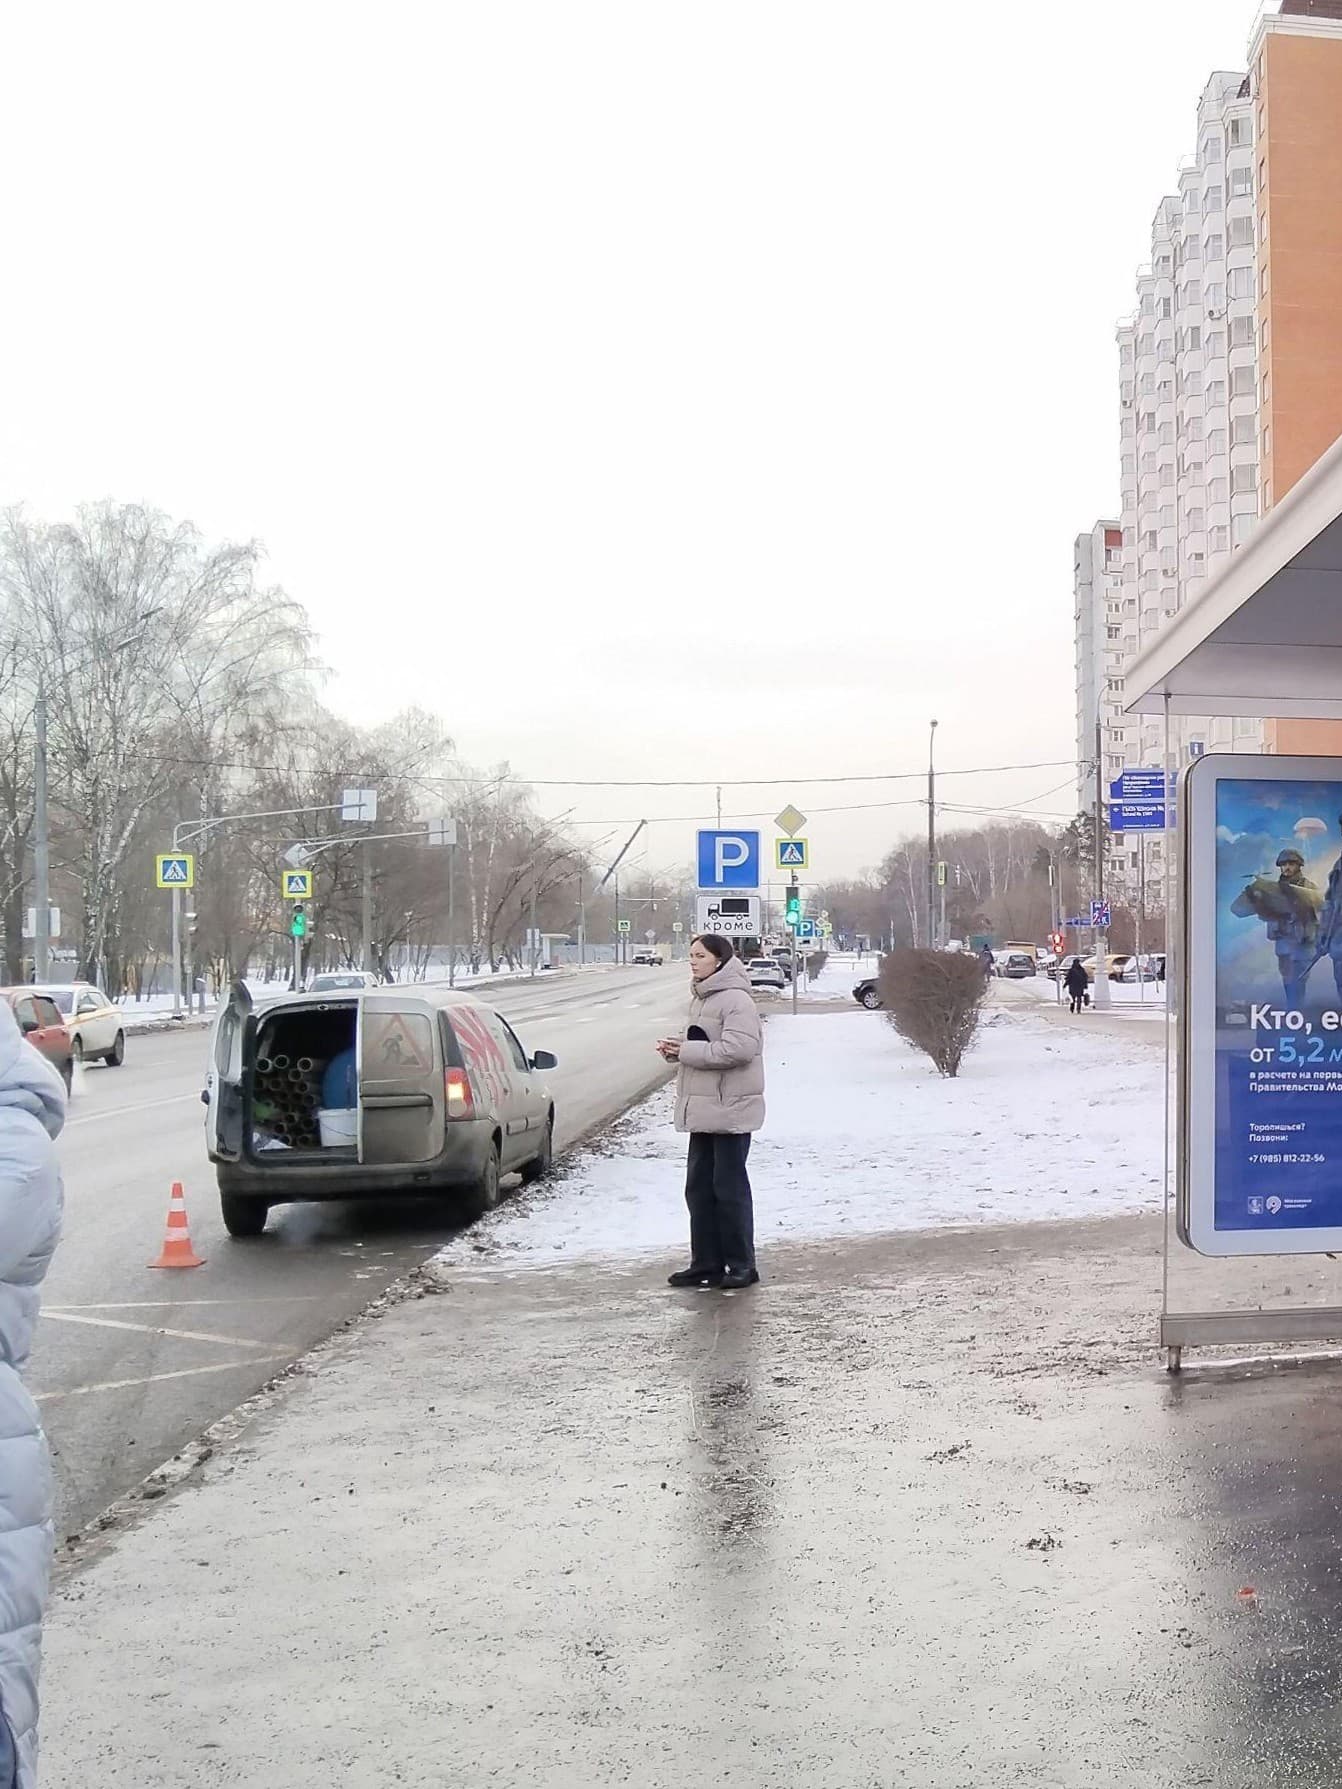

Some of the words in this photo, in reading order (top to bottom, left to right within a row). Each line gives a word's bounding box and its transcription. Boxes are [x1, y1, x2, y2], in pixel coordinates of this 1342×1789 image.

[715, 836, 749, 883] P
[703, 922, 753, 933] кроме
[1250, 1004, 1312, 1035] Кто,
[1250, 1048, 1275, 1063] от
[1278, 1037, 1325, 1067] 5,2
[1249, 1071, 1256, 1079] в
[1258, 1071, 1297, 1081] расчете
[1299, 1071, 1312, 1079] на
[1249, 1082, 1325, 1093] Правительства
[1249, 1123, 1306, 1133] Торопишься?
[1249, 1133, 1289, 1142] Позвони:
[1248, 1154, 1258, 1163] +7
